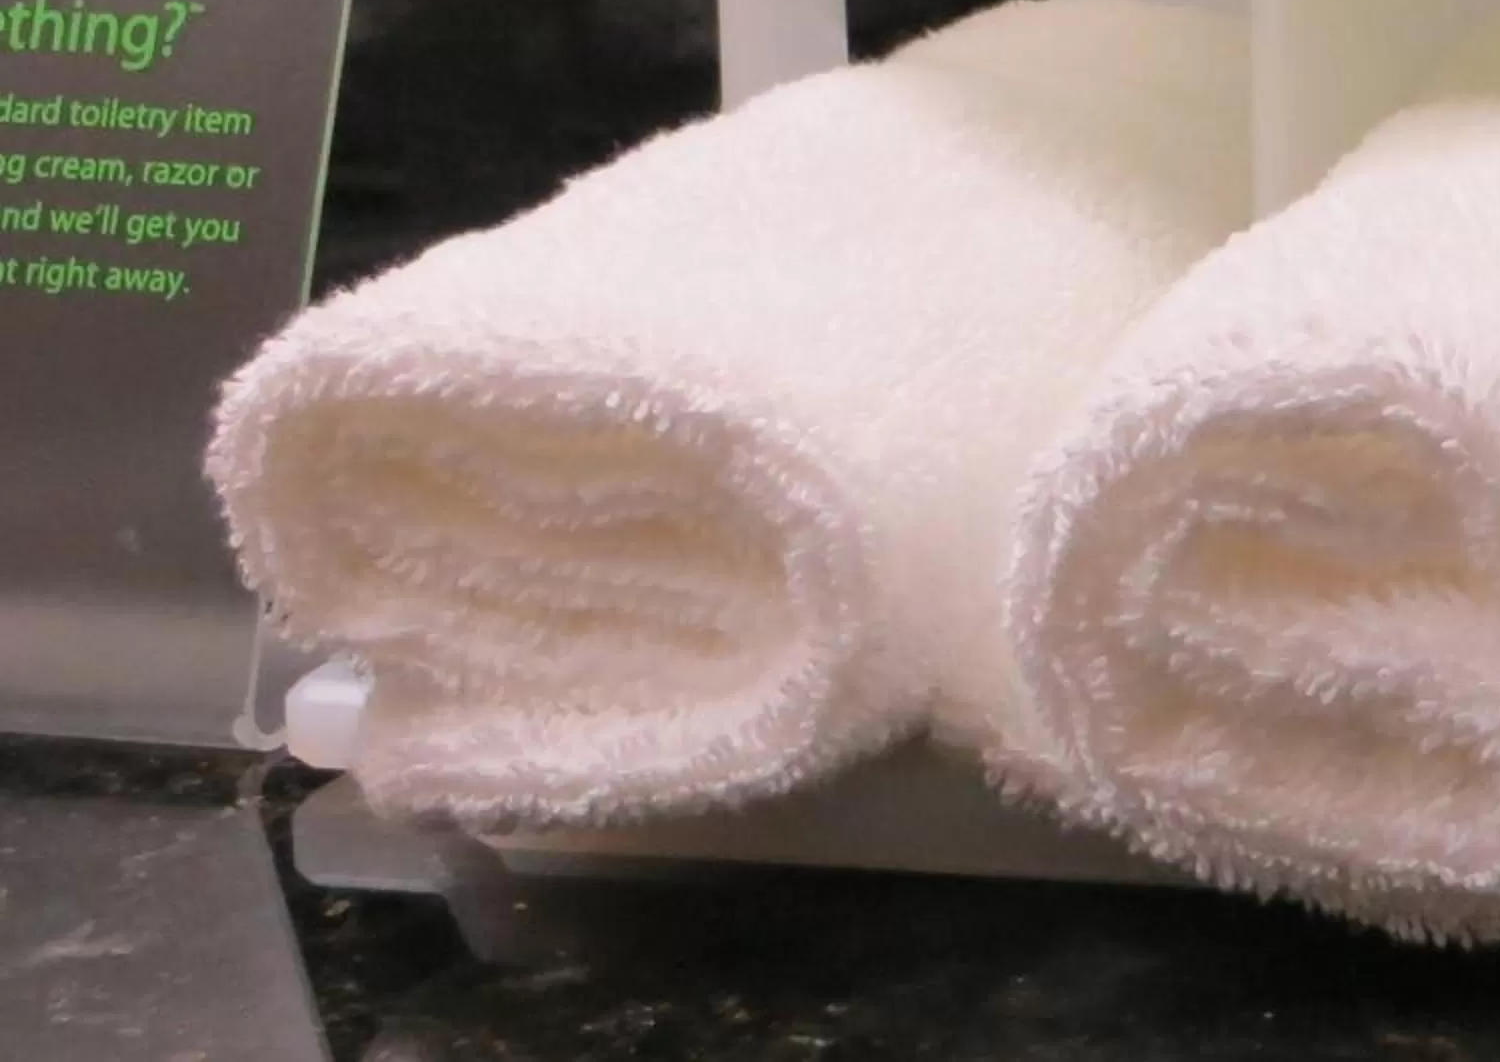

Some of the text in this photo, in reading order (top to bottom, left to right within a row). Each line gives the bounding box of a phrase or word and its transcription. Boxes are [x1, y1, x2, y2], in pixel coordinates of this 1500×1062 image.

[70, 98, 178, 138] toiletry
[184, 102, 253, 135] item
[34, 154, 133, 187] cream,
[143, 161, 217, 187] razor
[225, 165, 261, 189] or
[50, 205, 119, 235] we'll
[126, 210, 177, 244] get
[185, 219, 241, 249] you
[26, 257, 100, 294] right
[105, 268, 191, 301] away.
